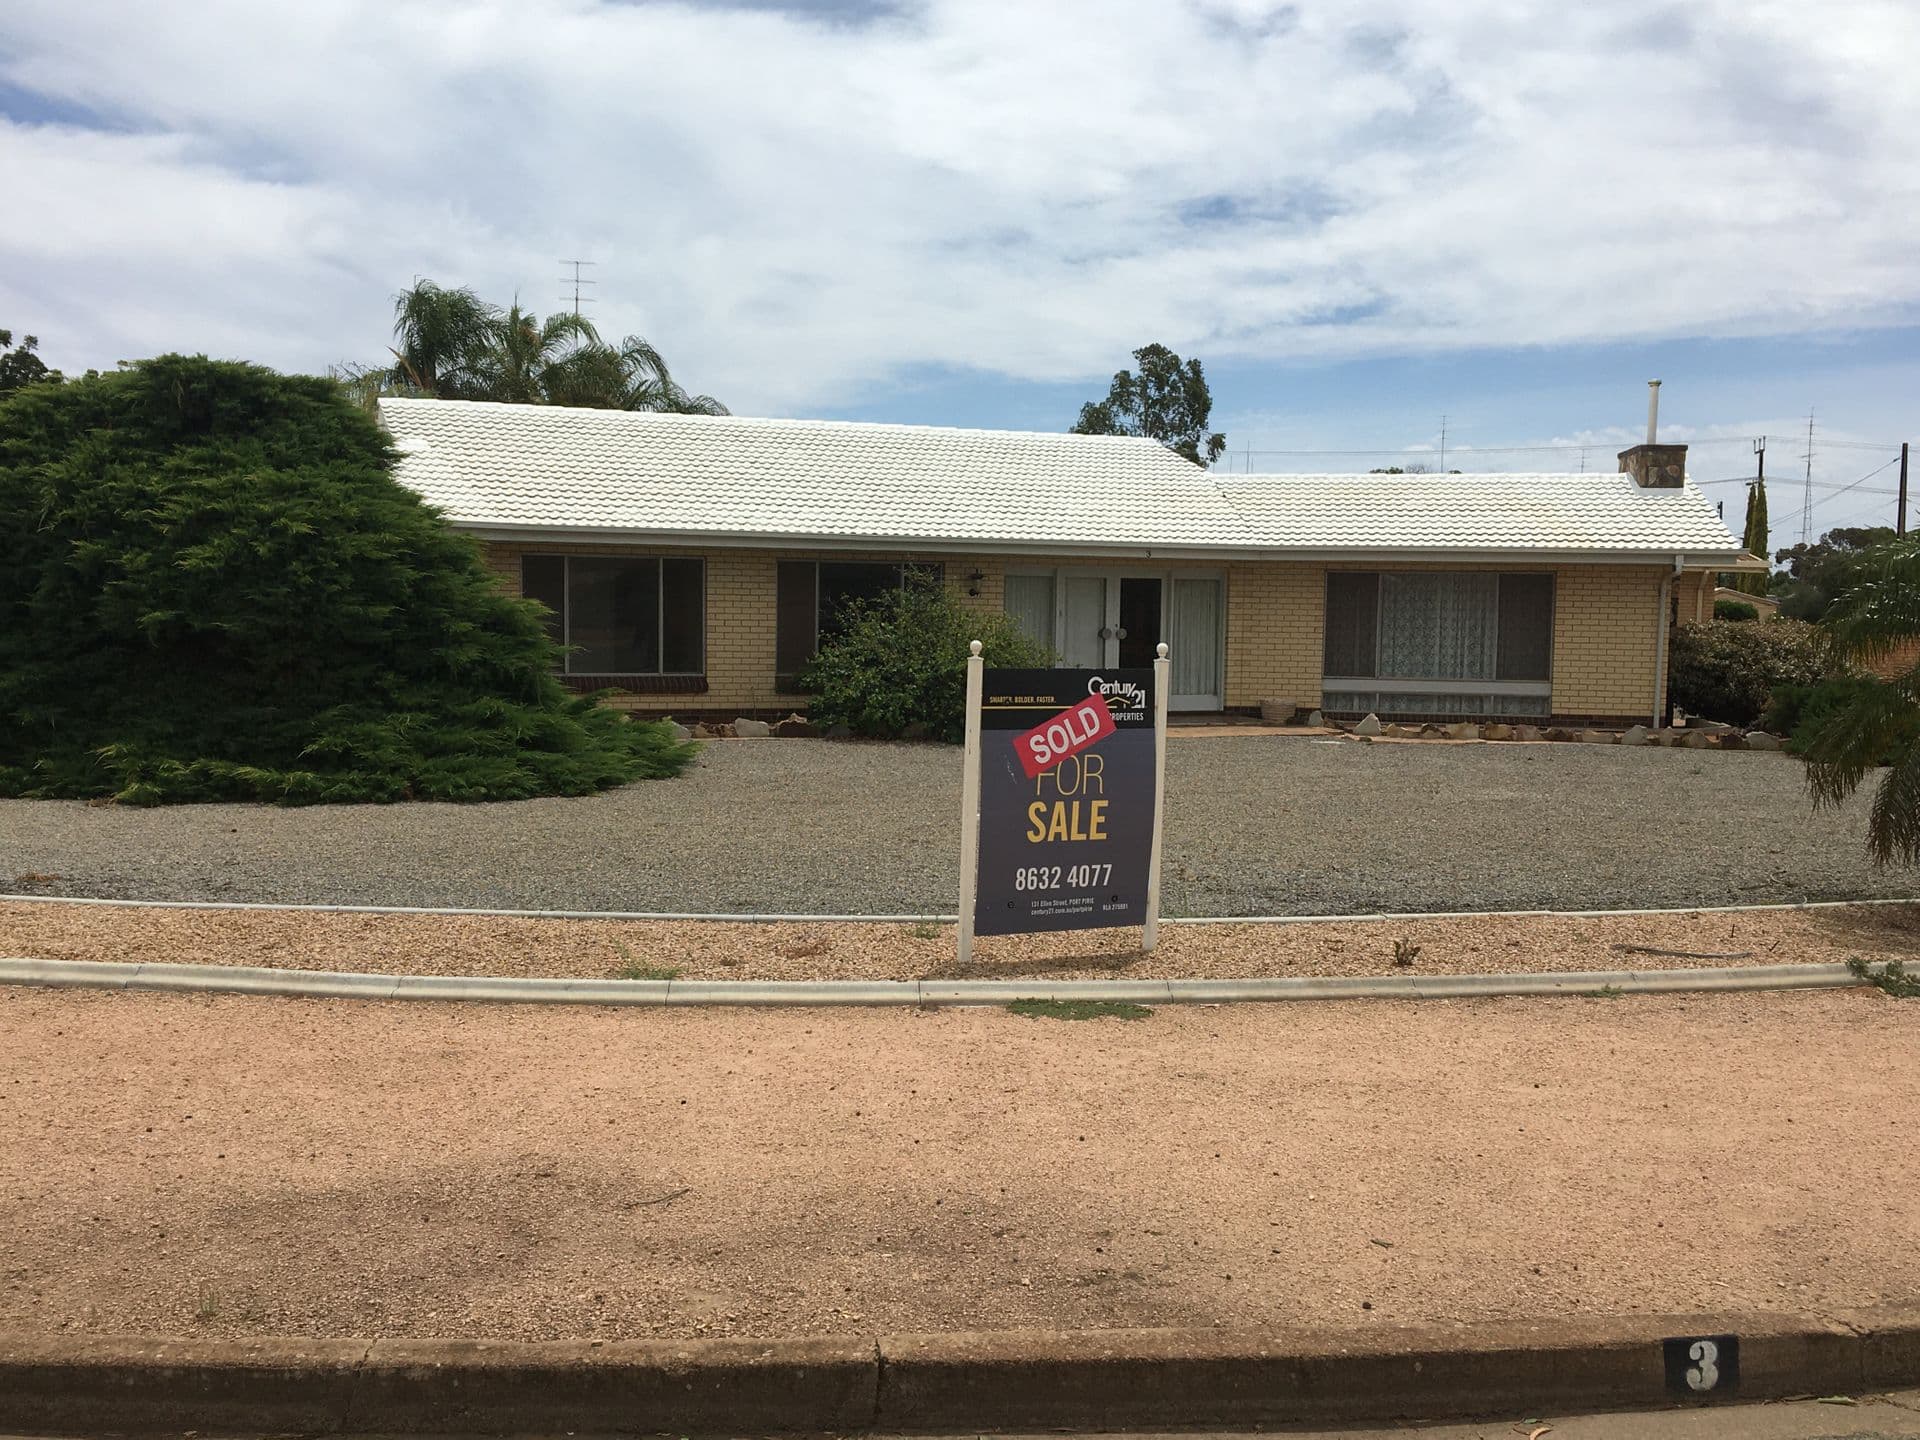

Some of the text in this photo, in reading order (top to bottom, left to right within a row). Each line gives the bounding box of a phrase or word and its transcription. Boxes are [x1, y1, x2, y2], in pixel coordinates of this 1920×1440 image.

[1087, 676, 1146, 709] Century 21
[1029, 706, 1100, 764] SOLD
[1026, 800, 1109, 843] SALE
[1015, 863, 1113, 891] 8632 4077
[1686, 1340, 1719, 1391] 3
